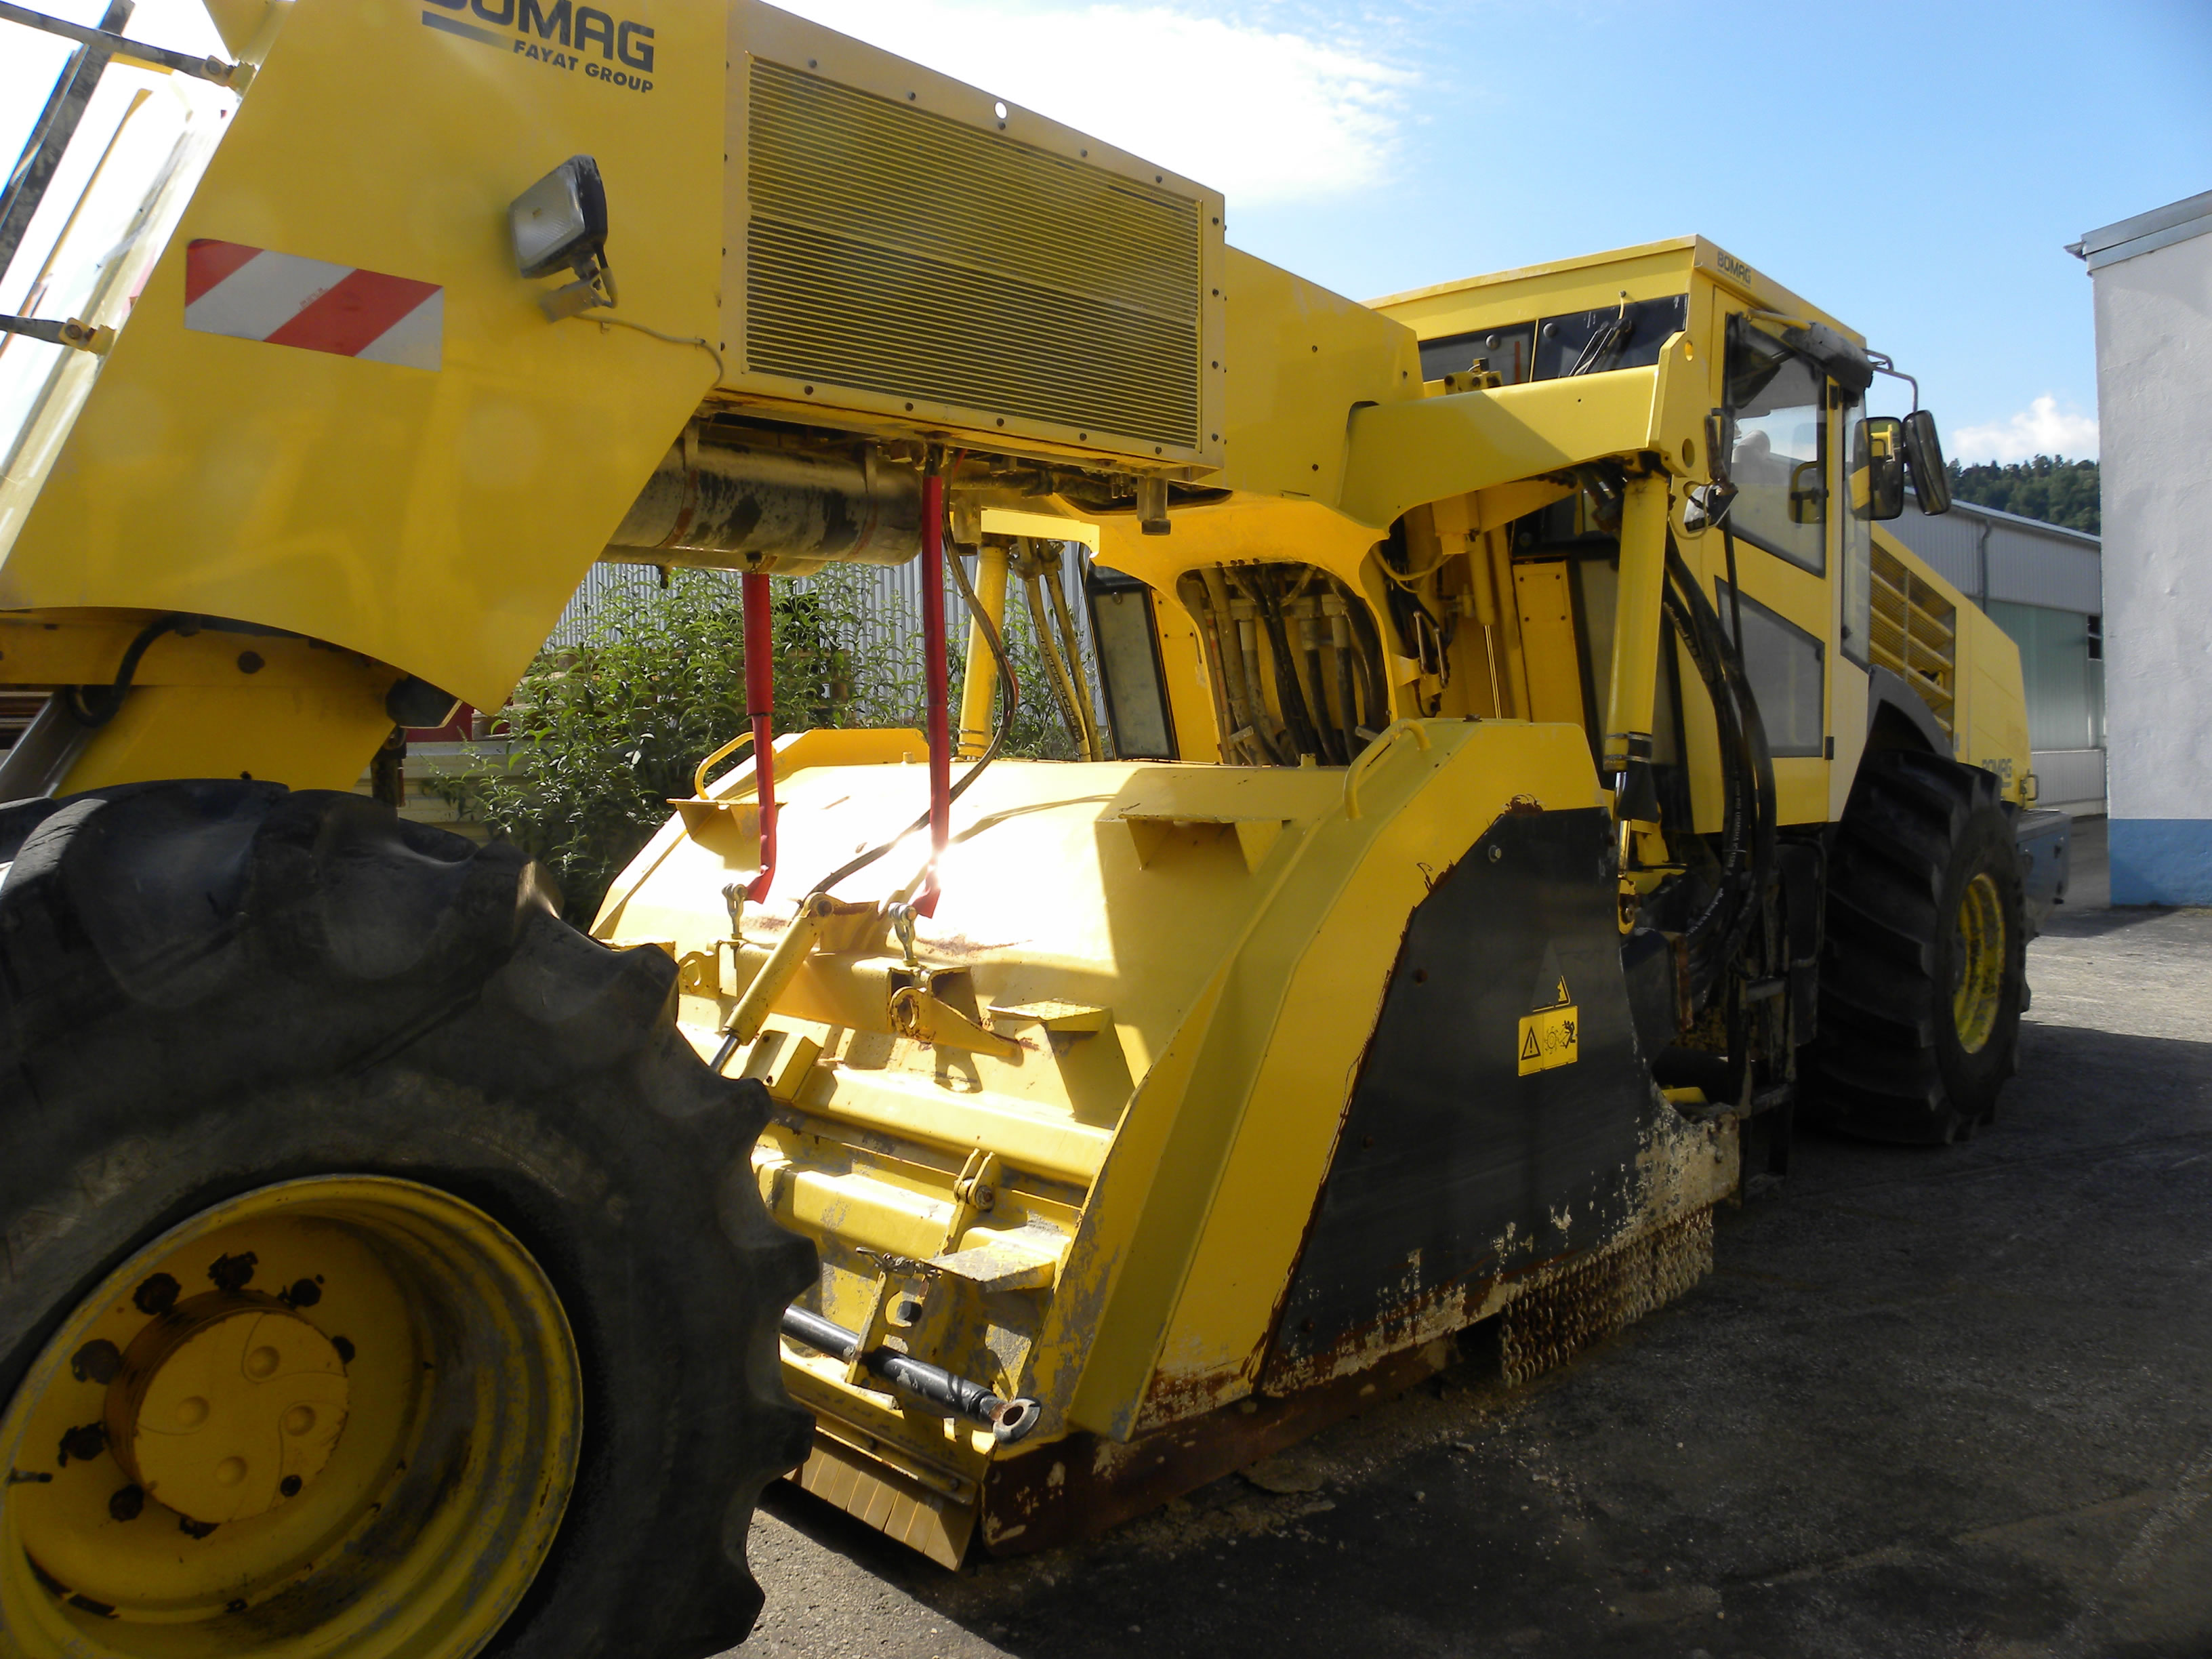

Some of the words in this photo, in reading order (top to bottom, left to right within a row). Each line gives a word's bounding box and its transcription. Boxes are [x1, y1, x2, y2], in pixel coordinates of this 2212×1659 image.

[423, 0, 655, 73] MAG
[513, 39, 579, 71] FAYAT
[585, 62, 654, 94] GROUP
[1717, 251, 1752, 284] BOMAG
